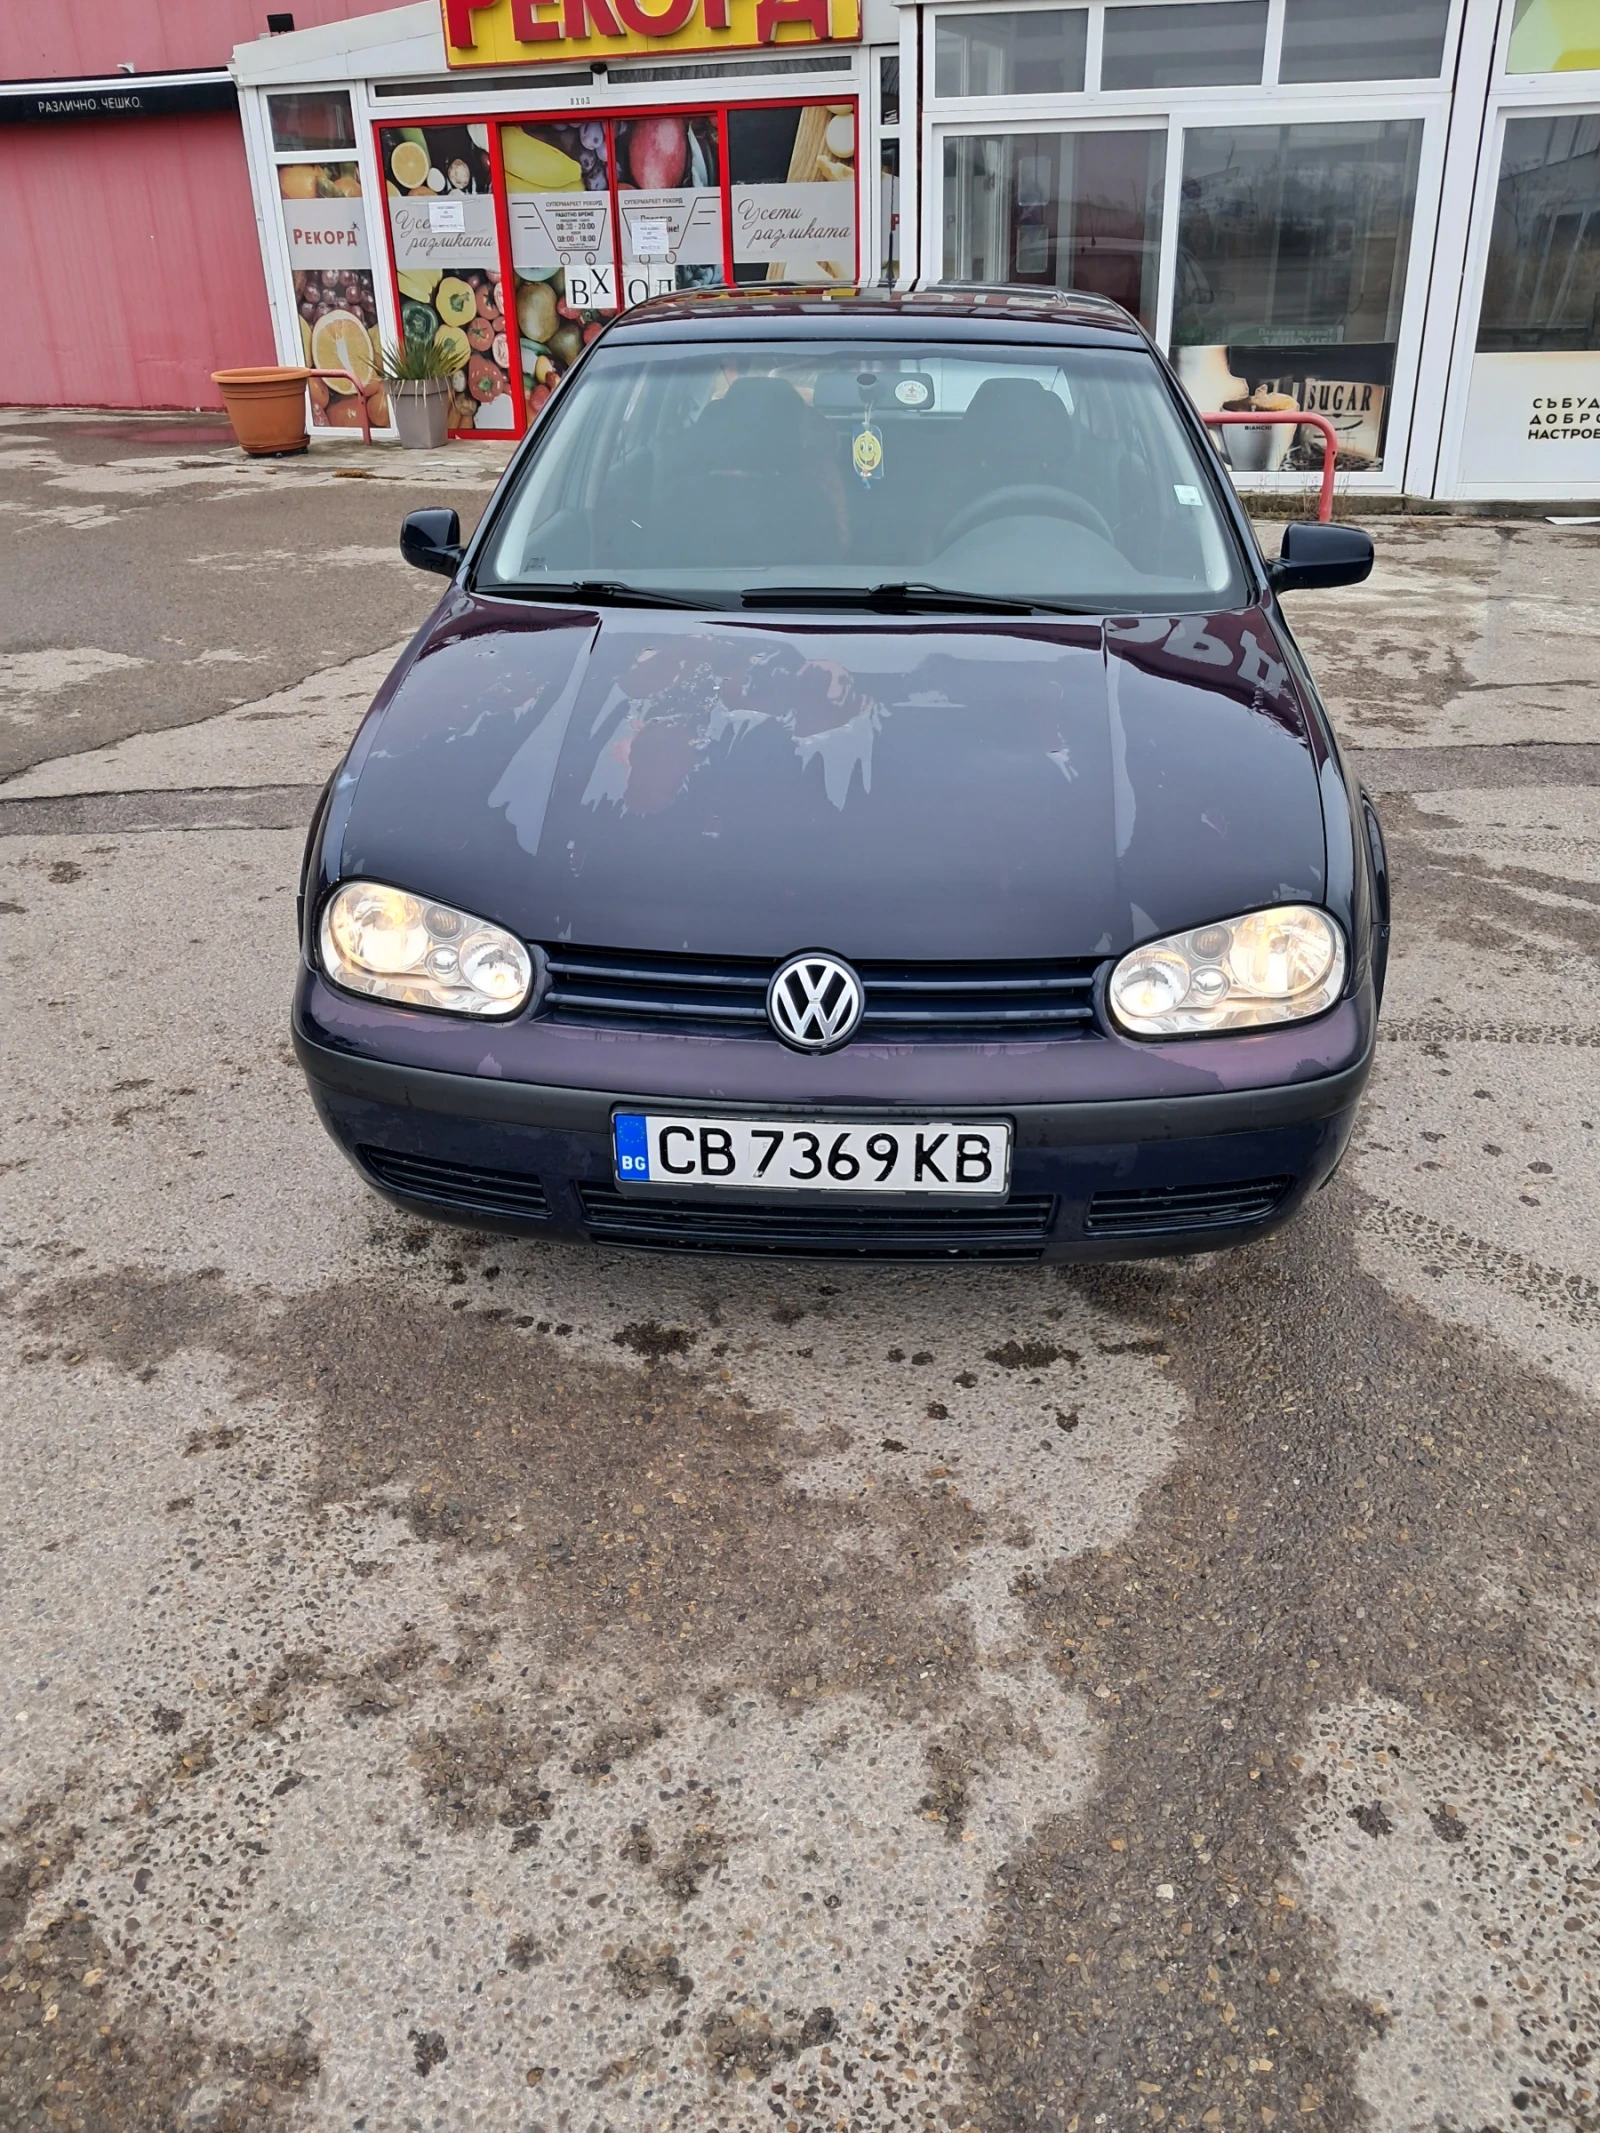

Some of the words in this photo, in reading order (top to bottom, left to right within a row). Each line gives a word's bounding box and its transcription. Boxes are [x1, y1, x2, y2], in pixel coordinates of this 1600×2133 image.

[395, 209, 431, 239] Усе
[1307, 384, 1373, 412] SUGAR
[621, 1155, 647, 1171] BG
[657, 1125, 737, 1177] CB
[750, 1129, 900, 1183] 7369
[914, 1132, 993, 1184] KB
